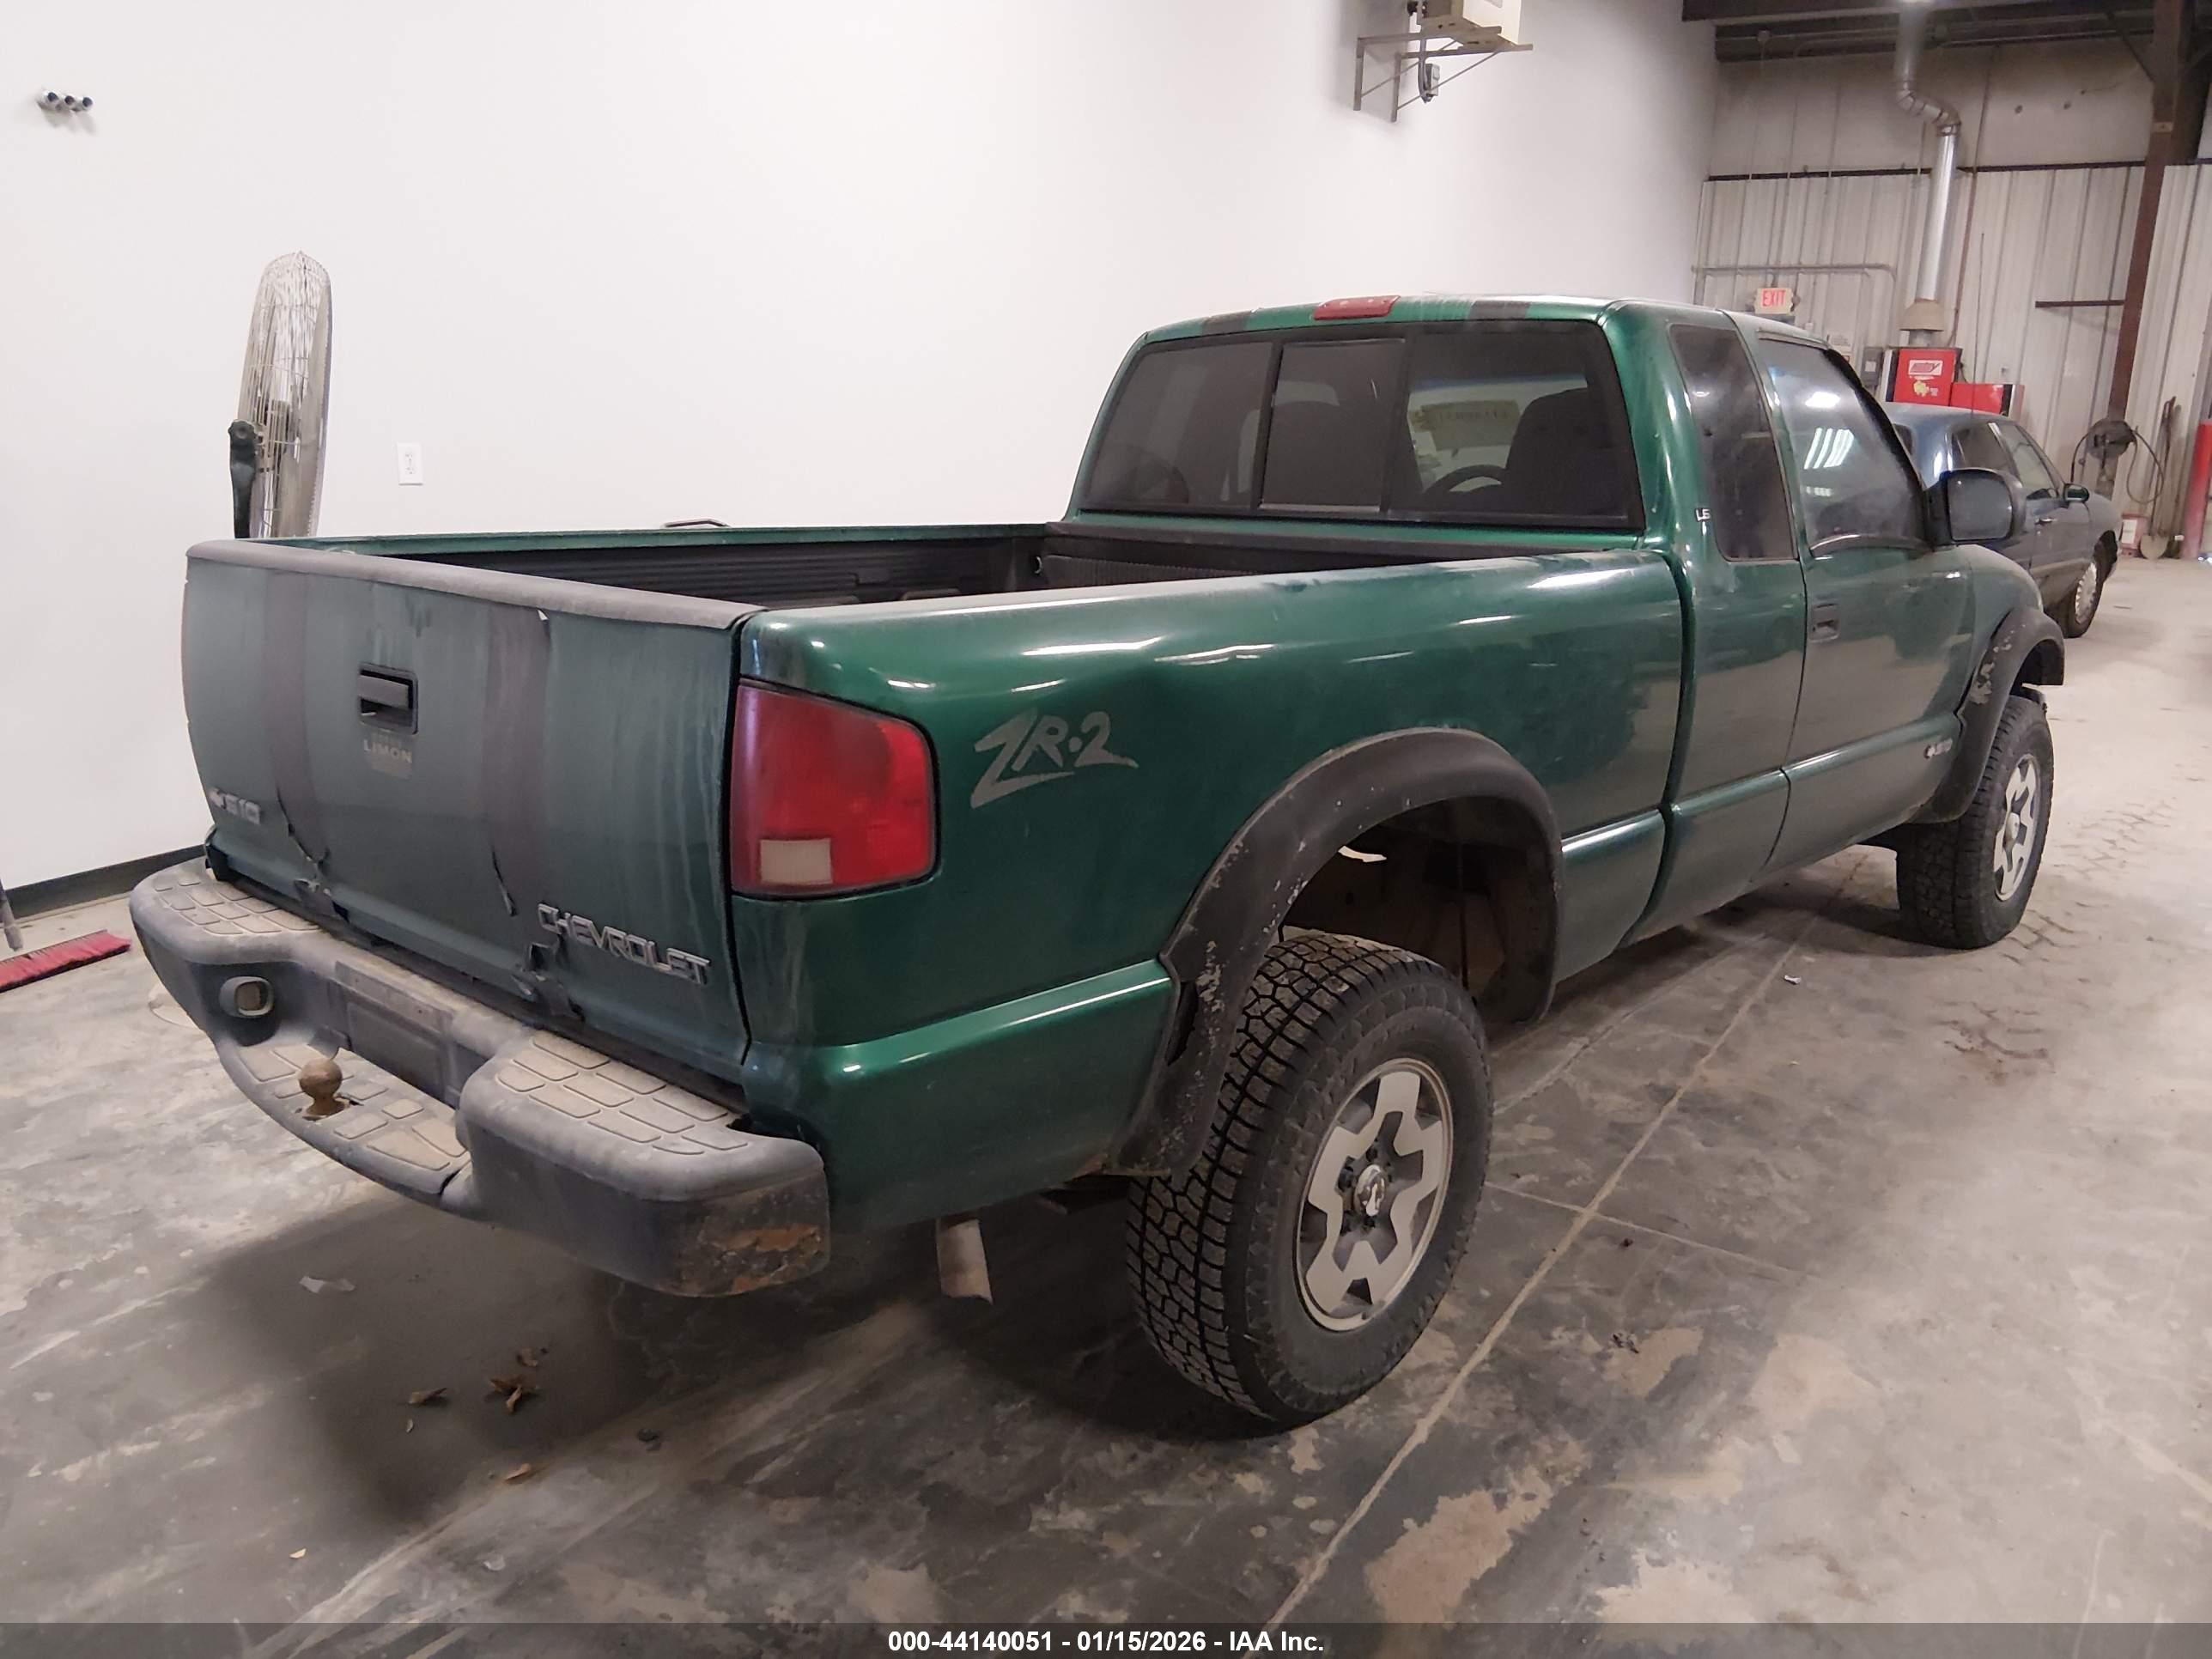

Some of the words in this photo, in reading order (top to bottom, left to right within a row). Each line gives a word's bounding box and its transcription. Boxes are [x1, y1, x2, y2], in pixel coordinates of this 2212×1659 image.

[1762, 289, 1786, 307] EXIT
[1695, 508, 1711, 521] LS
[538, 903, 711, 984] CHEVROLET
